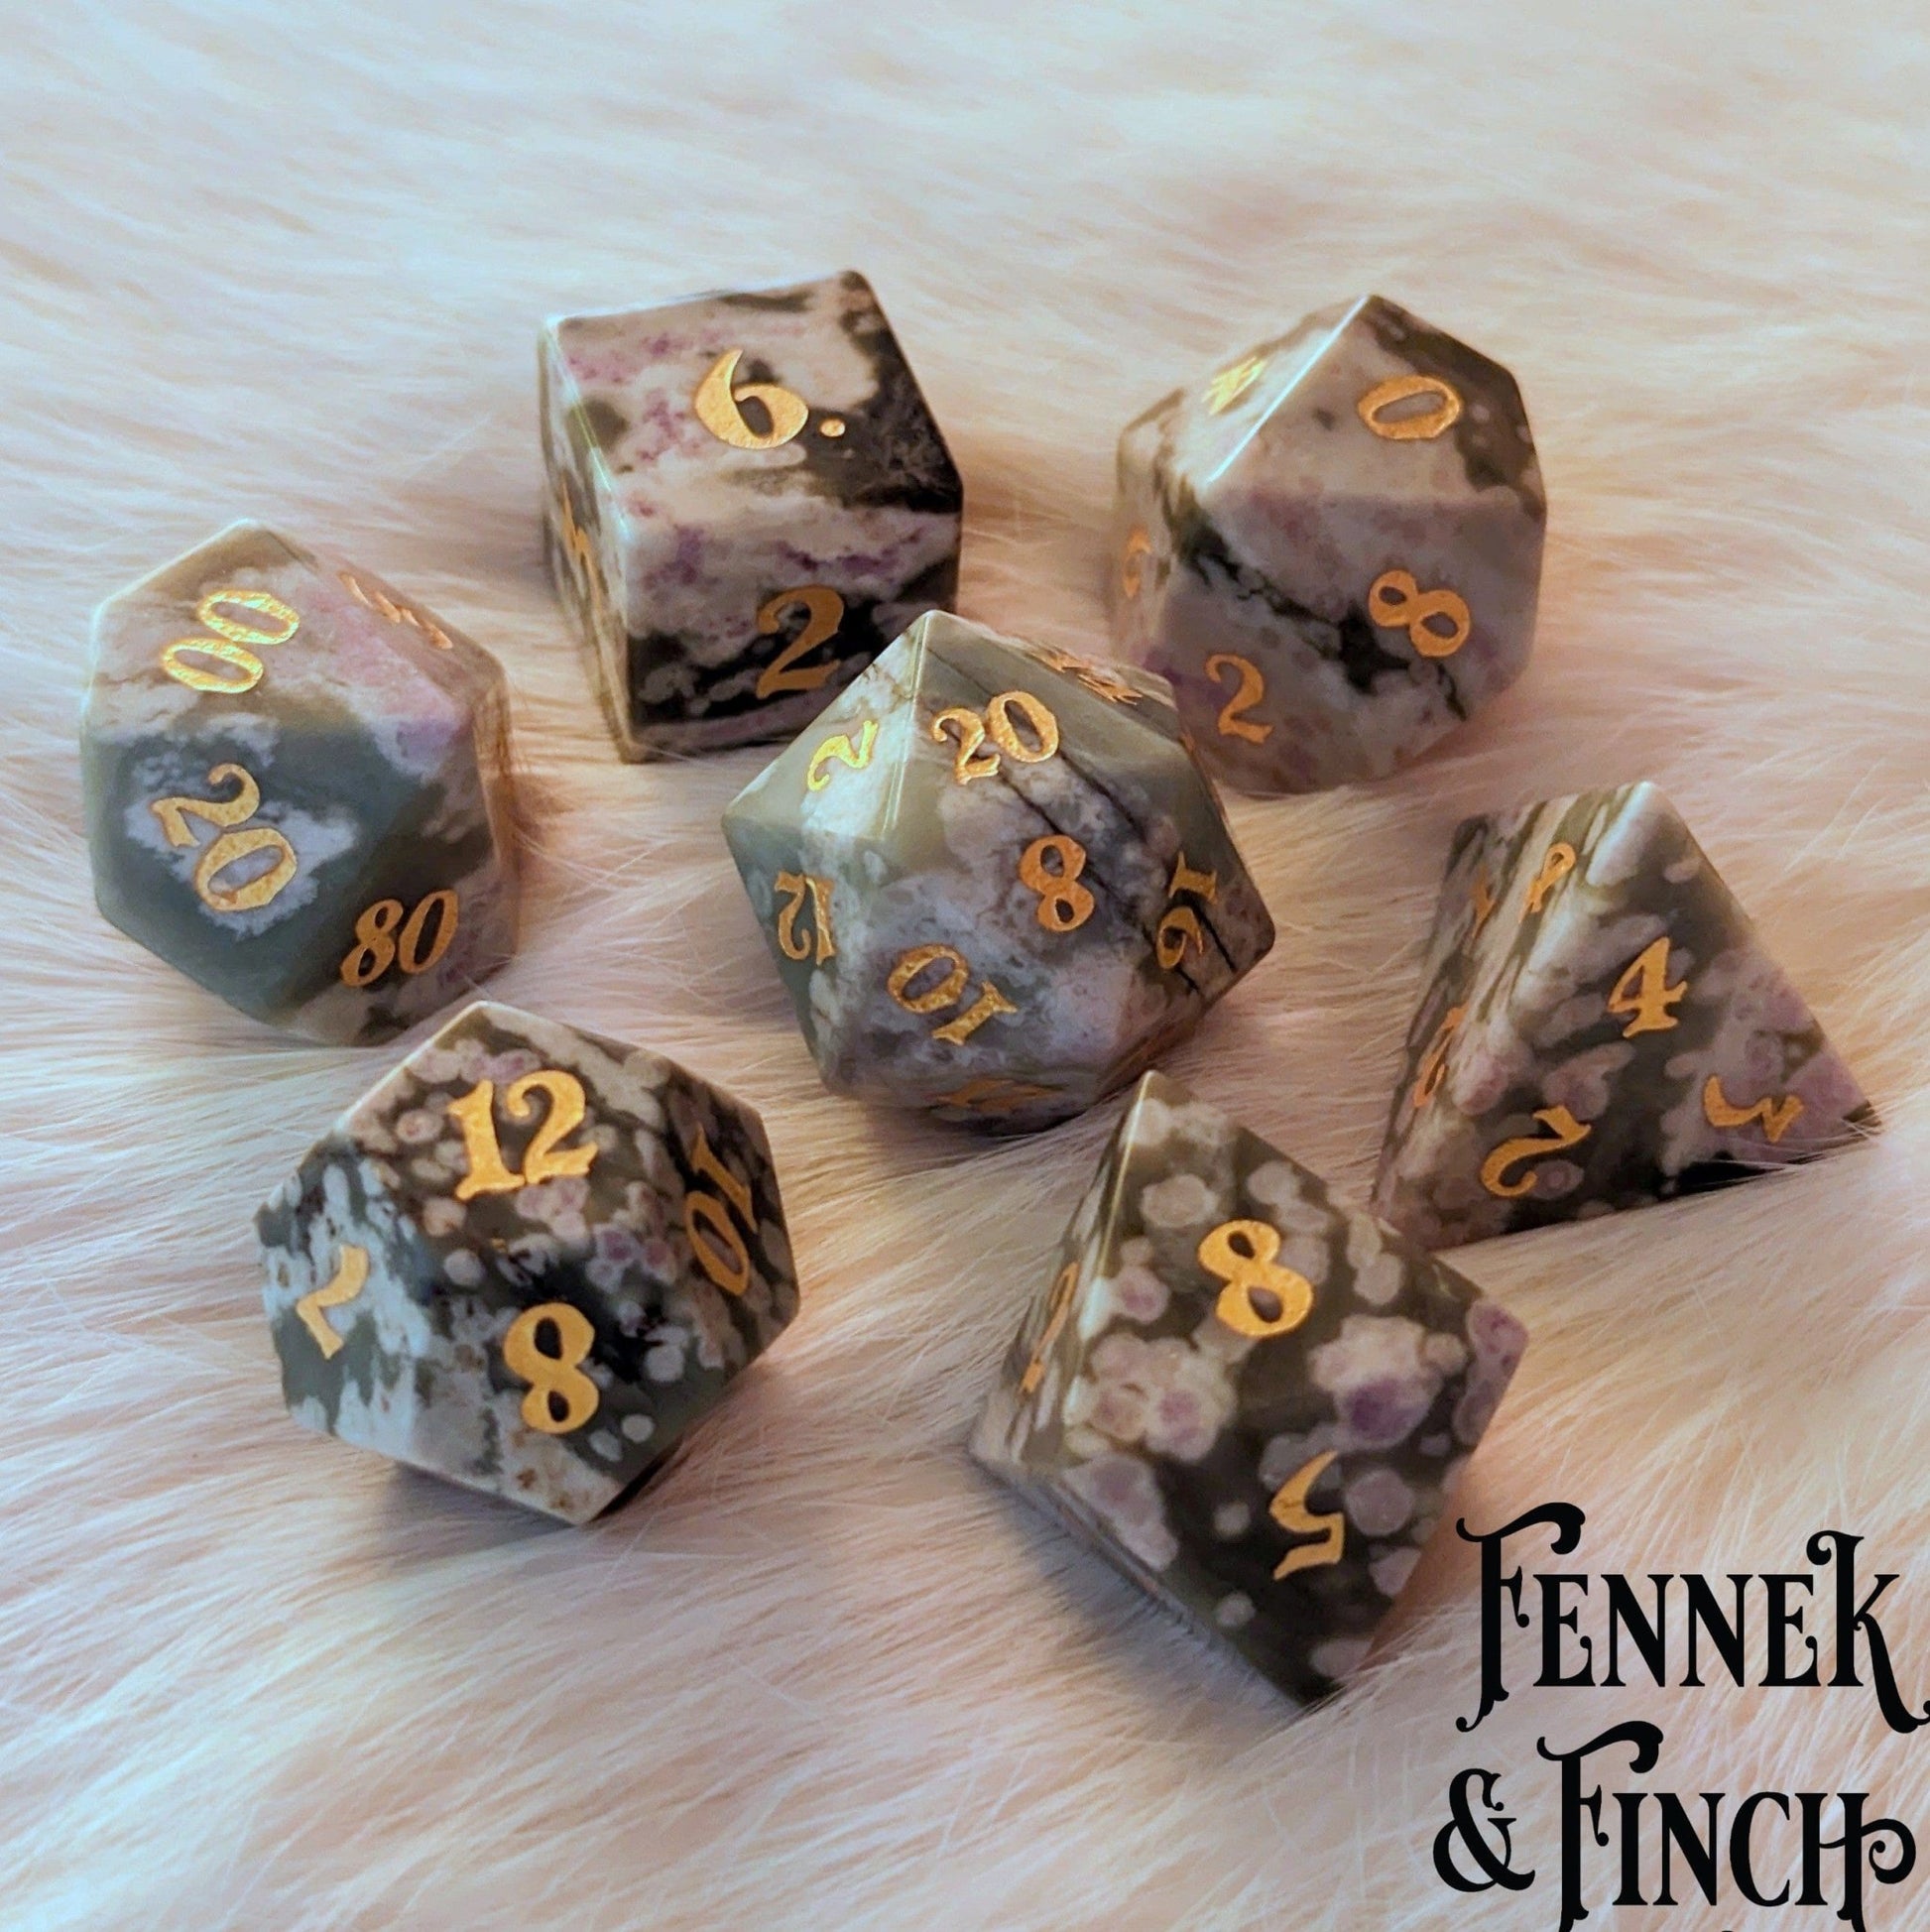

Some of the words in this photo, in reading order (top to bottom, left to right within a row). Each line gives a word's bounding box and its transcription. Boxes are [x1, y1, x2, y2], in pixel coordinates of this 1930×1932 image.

[1358, 375, 1463, 440] 0
[161, 589, 300, 693] 00
[756, 583, 845, 699] 2
[1369, 569, 1471, 658] 8
[931, 690, 1060, 785] 20
[1205, 654, 1273, 744] 2
[806, 719, 880, 792] 2
[151, 763, 298, 911] 20
[1020, 834, 1095, 933] 8
[339, 889, 458, 987] 80
[774, 870, 837, 965] 12
[887, 943, 1018, 1046] 10
[1608, 936, 1688, 1038] 4
[446, 1070, 598, 1201] 12
[1480, 1104, 1591, 1198] 2
[1703, 1075, 1804, 1143] 3
[685, 1121, 758, 1297] 10
[1198, 1219, 1314, 1339] 8
[503, 1302, 600, 1435] 8
[1268, 1451, 1345, 1582] 5
